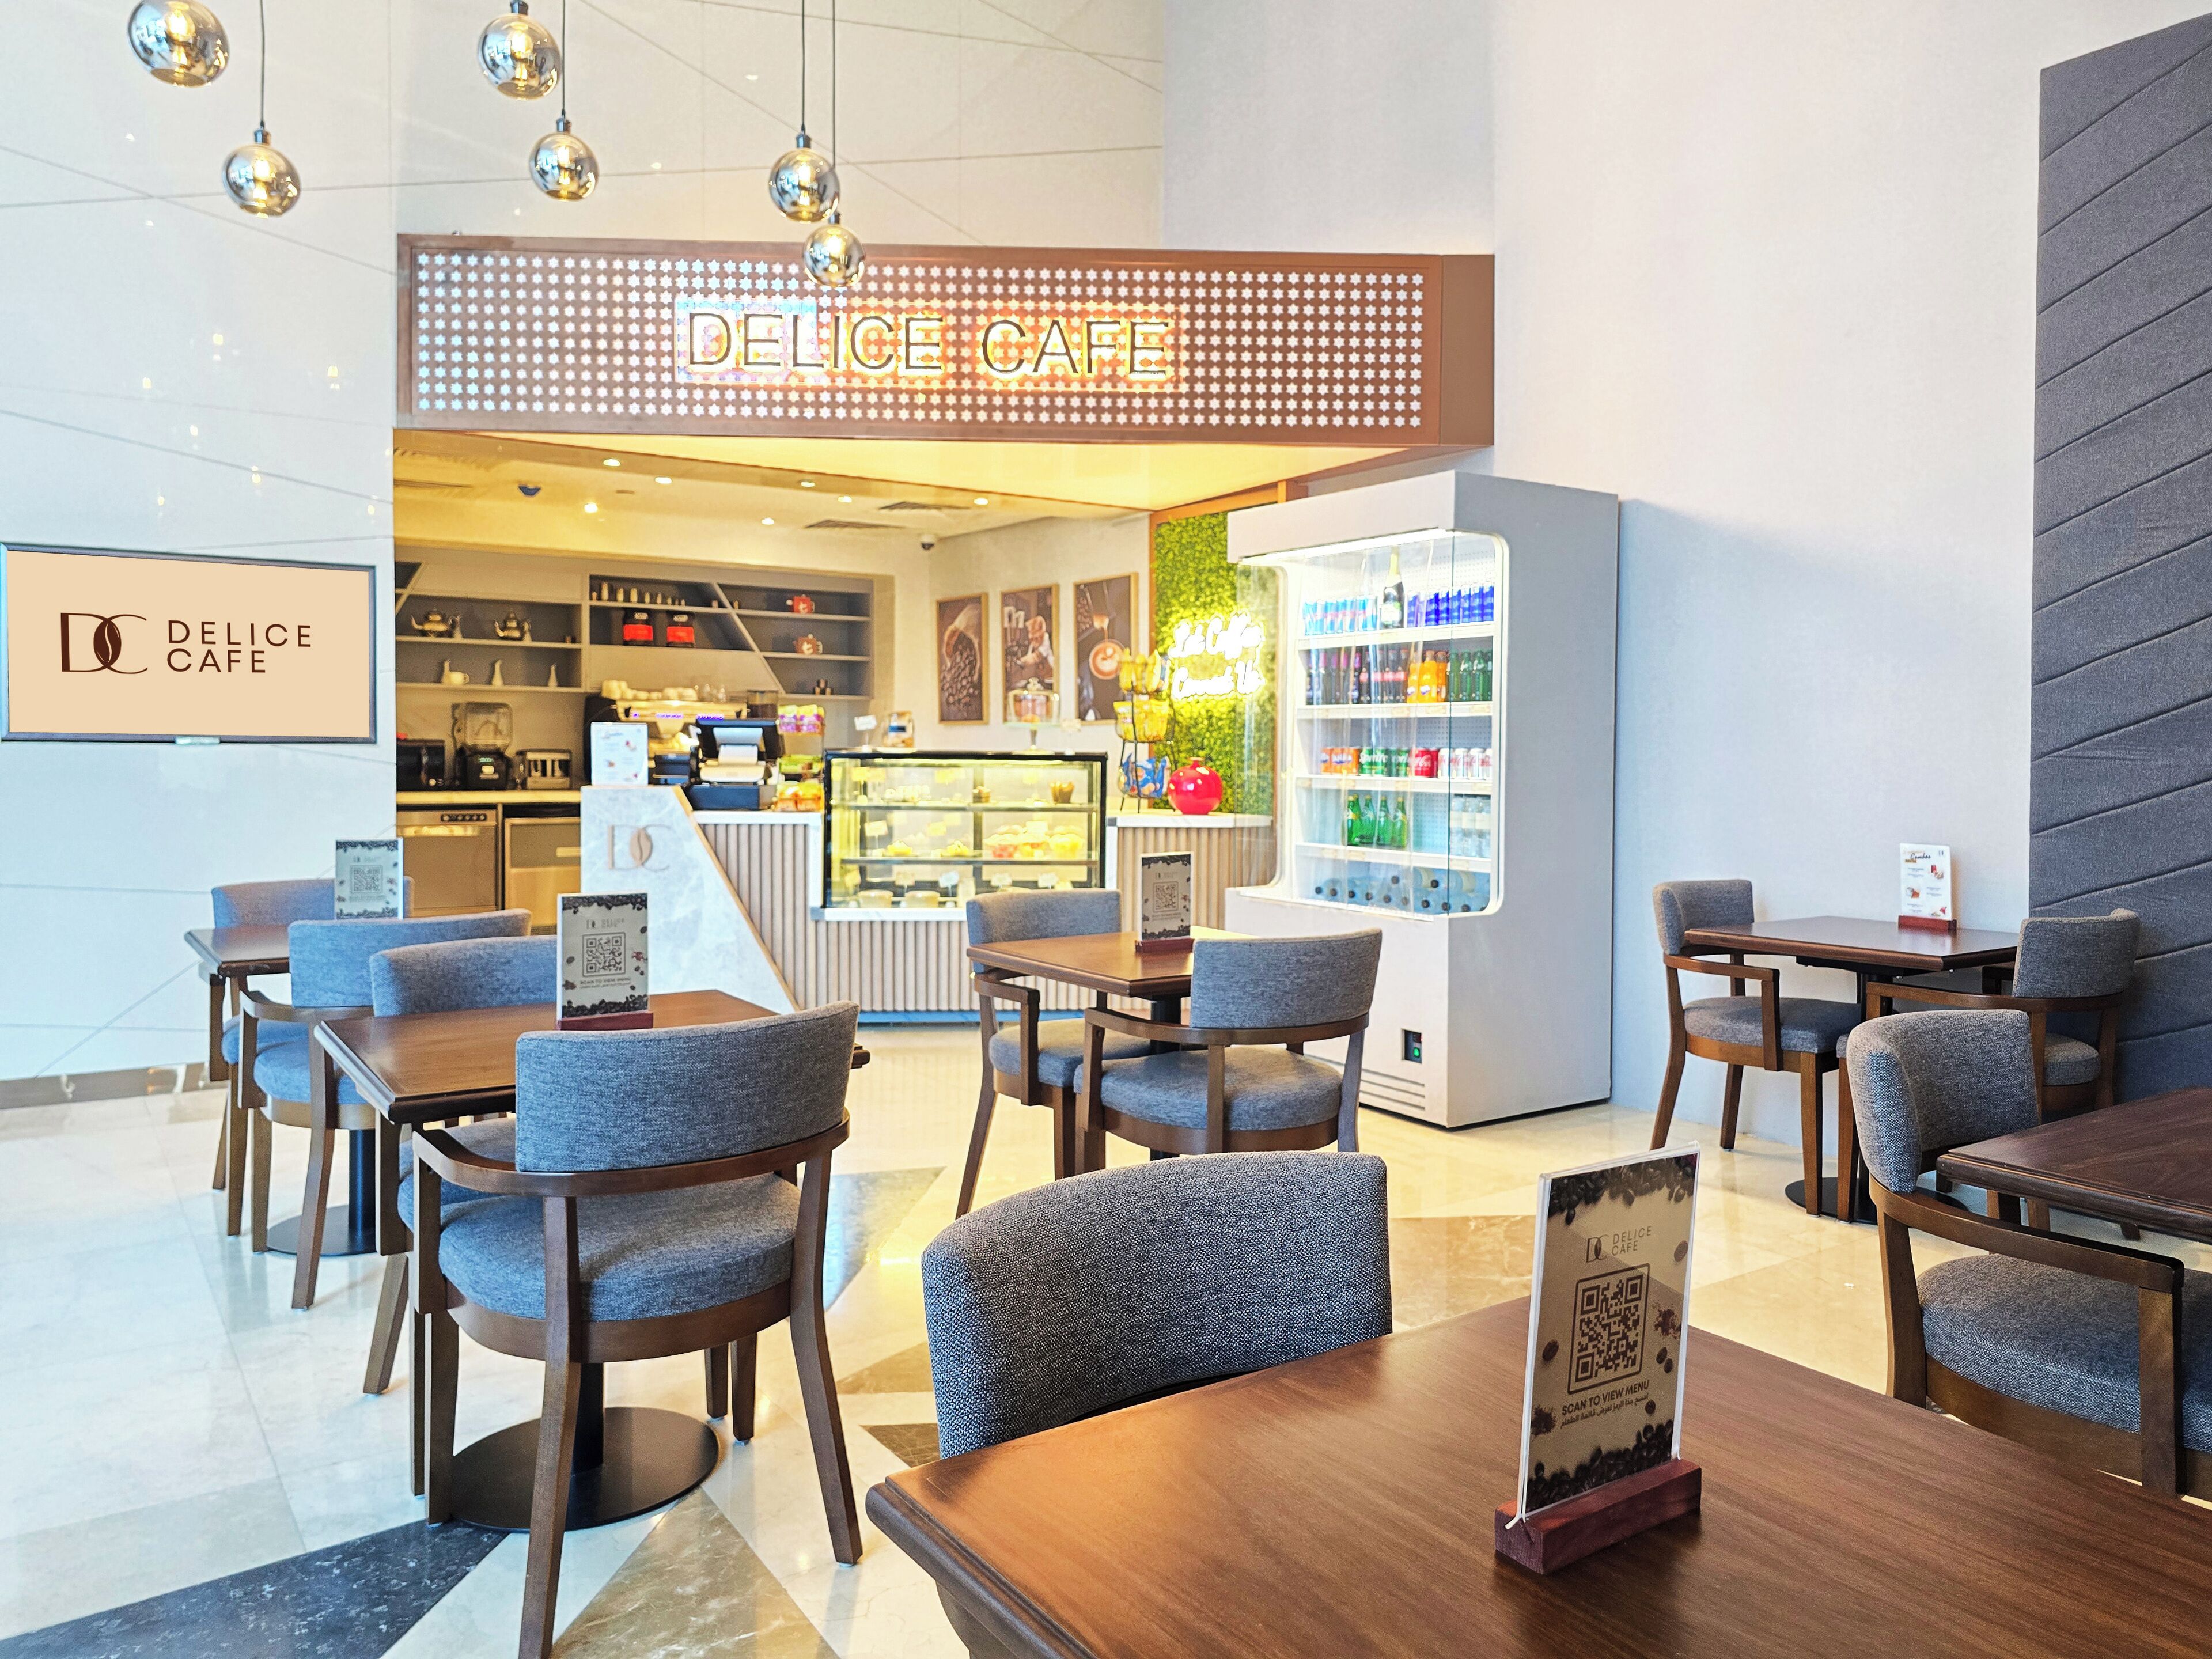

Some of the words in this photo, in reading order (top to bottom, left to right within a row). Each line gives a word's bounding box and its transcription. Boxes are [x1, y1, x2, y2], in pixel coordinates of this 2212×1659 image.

[688, 311, 945, 370] DELICE
[981, 318, 1170, 374] CAFE
[168, 620, 312, 647] DELICE
[167, 648, 266, 673] CAFE
[1613, 1225, 1652, 1244] DELICE
[1611, 1240, 1638, 1256] CAFE
[1562, 1399, 1587, 1416] SCAN
[1589, 1395, 1600, 1407] TO
[1601, 1388, 1624, 1403] VIEW
[1625, 1380, 1650, 1396] MENU
